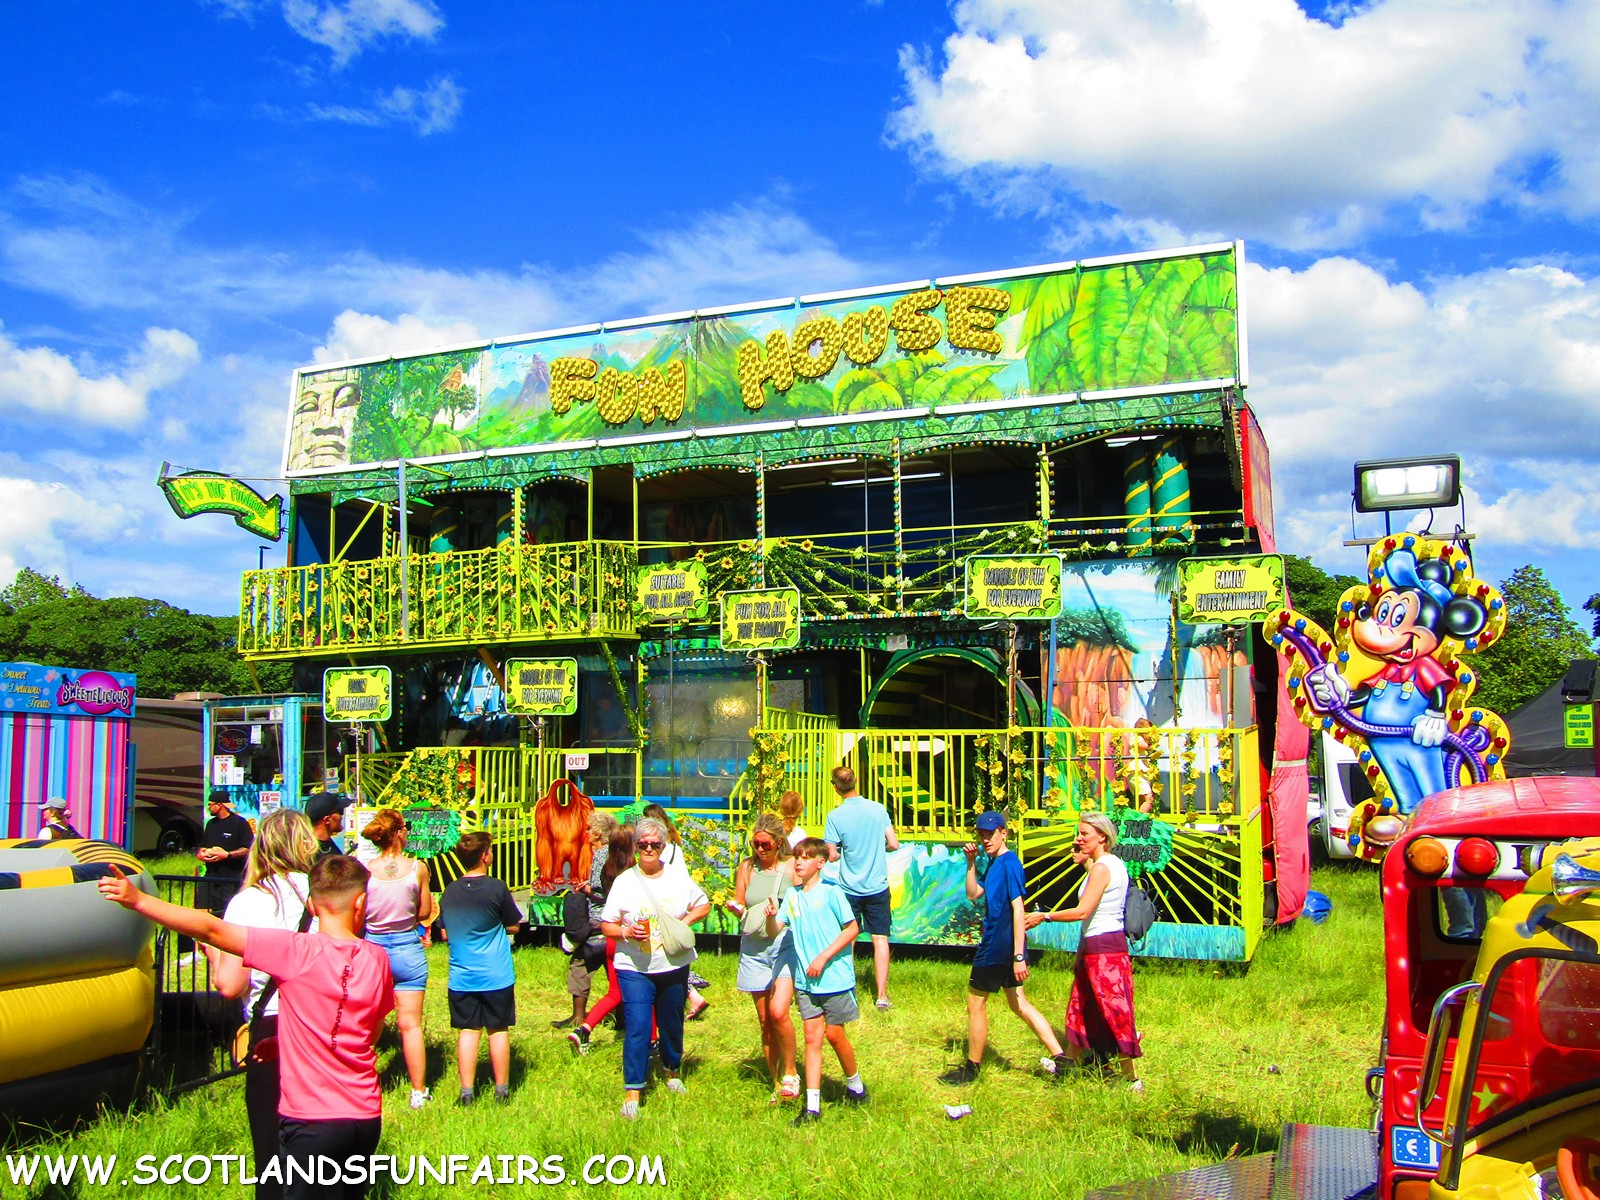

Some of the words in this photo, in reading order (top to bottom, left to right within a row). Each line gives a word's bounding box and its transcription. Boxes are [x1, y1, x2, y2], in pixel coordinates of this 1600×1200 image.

[550, 357, 686, 424] FUN
[739, 286, 1011, 410] HOUSE
[180, 482, 204, 502] IT'S
[204, 481, 226, 499] THE
[650, 573, 686, 591] SUITABLE
[984, 567, 1018, 586] BARRELS
[1018, 567, 1029, 586] OF
[1029, 567, 1045, 586] FUN
[1215, 569, 1246, 589] FAMILY
[643, 593, 659, 610] FOR
[660, 592, 673, 609] ALL
[674, 590, 694, 608] AGES
[986, 588, 1002, 607] FOR
[1002, 588, 1042, 607] EVERYONE
[1196, 591, 1267, 613] ENTERTAINMENT
[735, 602, 753, 620] FUN
[753, 601, 771, 620] FOR
[771, 600, 787, 618] ALL
[737, 622, 753, 640] THE
[754, 620, 786, 639] FAMILY
[2, 667, 28, 680] Sweet
[9, 682, 42, 695] Delicious
[27, 696, 52, 709] Treats
[568, 757, 586, 766] OUT
[427, 824, 448, 836] THE
[1124, 819, 1153, 839] THE
[341, 964, 351, 1002] UNDER
[330, 1002, 345, 1052] ARMOUR
